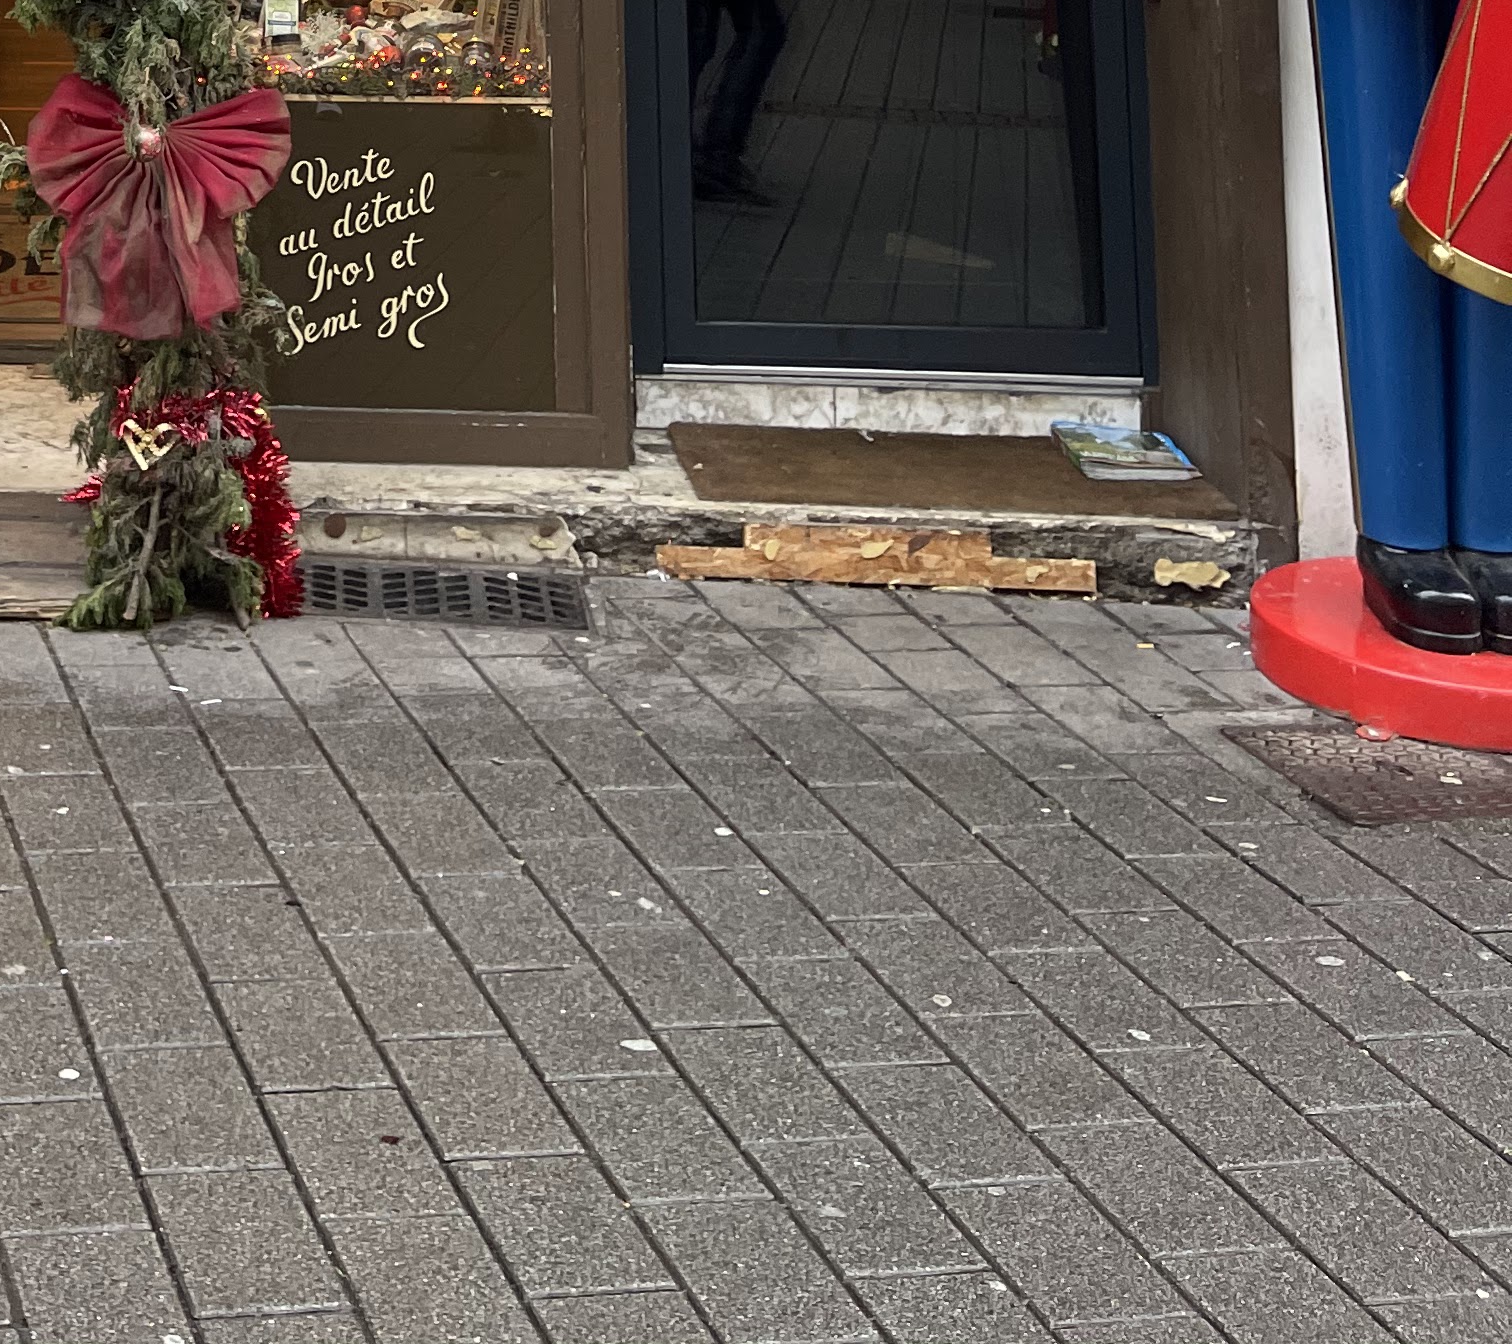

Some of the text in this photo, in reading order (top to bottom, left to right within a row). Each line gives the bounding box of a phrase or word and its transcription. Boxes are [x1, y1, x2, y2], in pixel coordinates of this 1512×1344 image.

[290, 148, 395, 200] Vente
[279, 172, 435, 255] au détail
[391, 232, 425, 270] et
[283, 272, 450, 356] Semi gros
